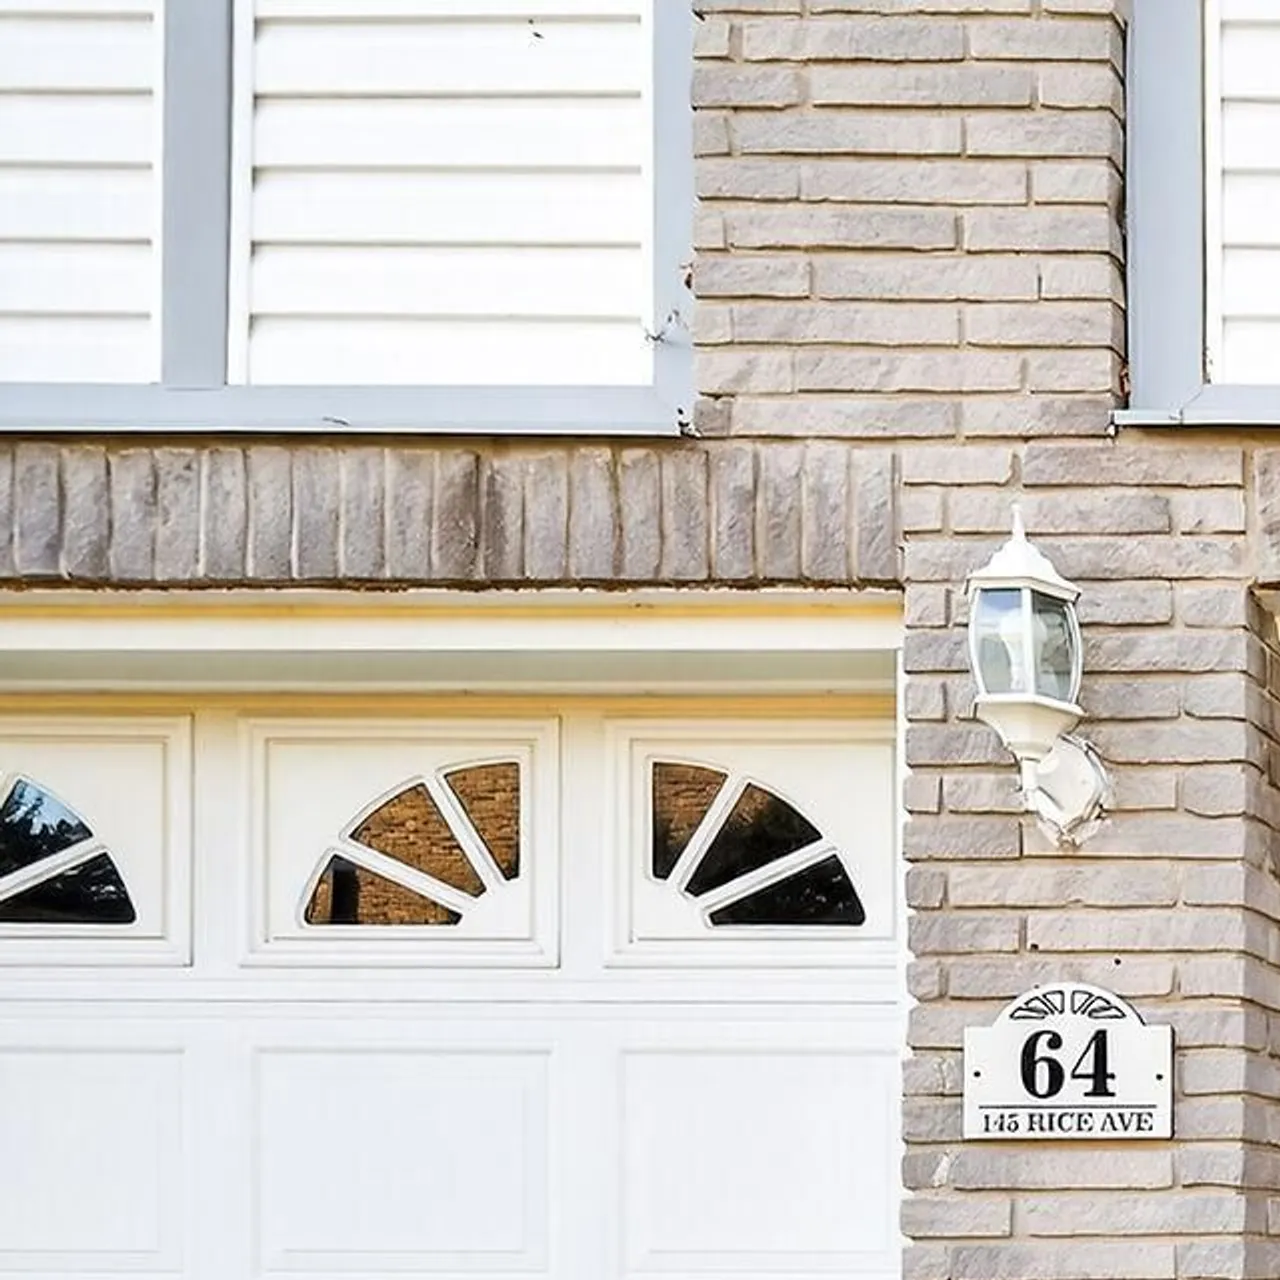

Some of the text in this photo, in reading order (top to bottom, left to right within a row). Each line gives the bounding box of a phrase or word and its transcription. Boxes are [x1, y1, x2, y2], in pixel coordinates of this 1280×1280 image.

[1020, 1029, 1116, 1099] 64
[983, 1112, 1154, 1132] 145 RICE AVE
